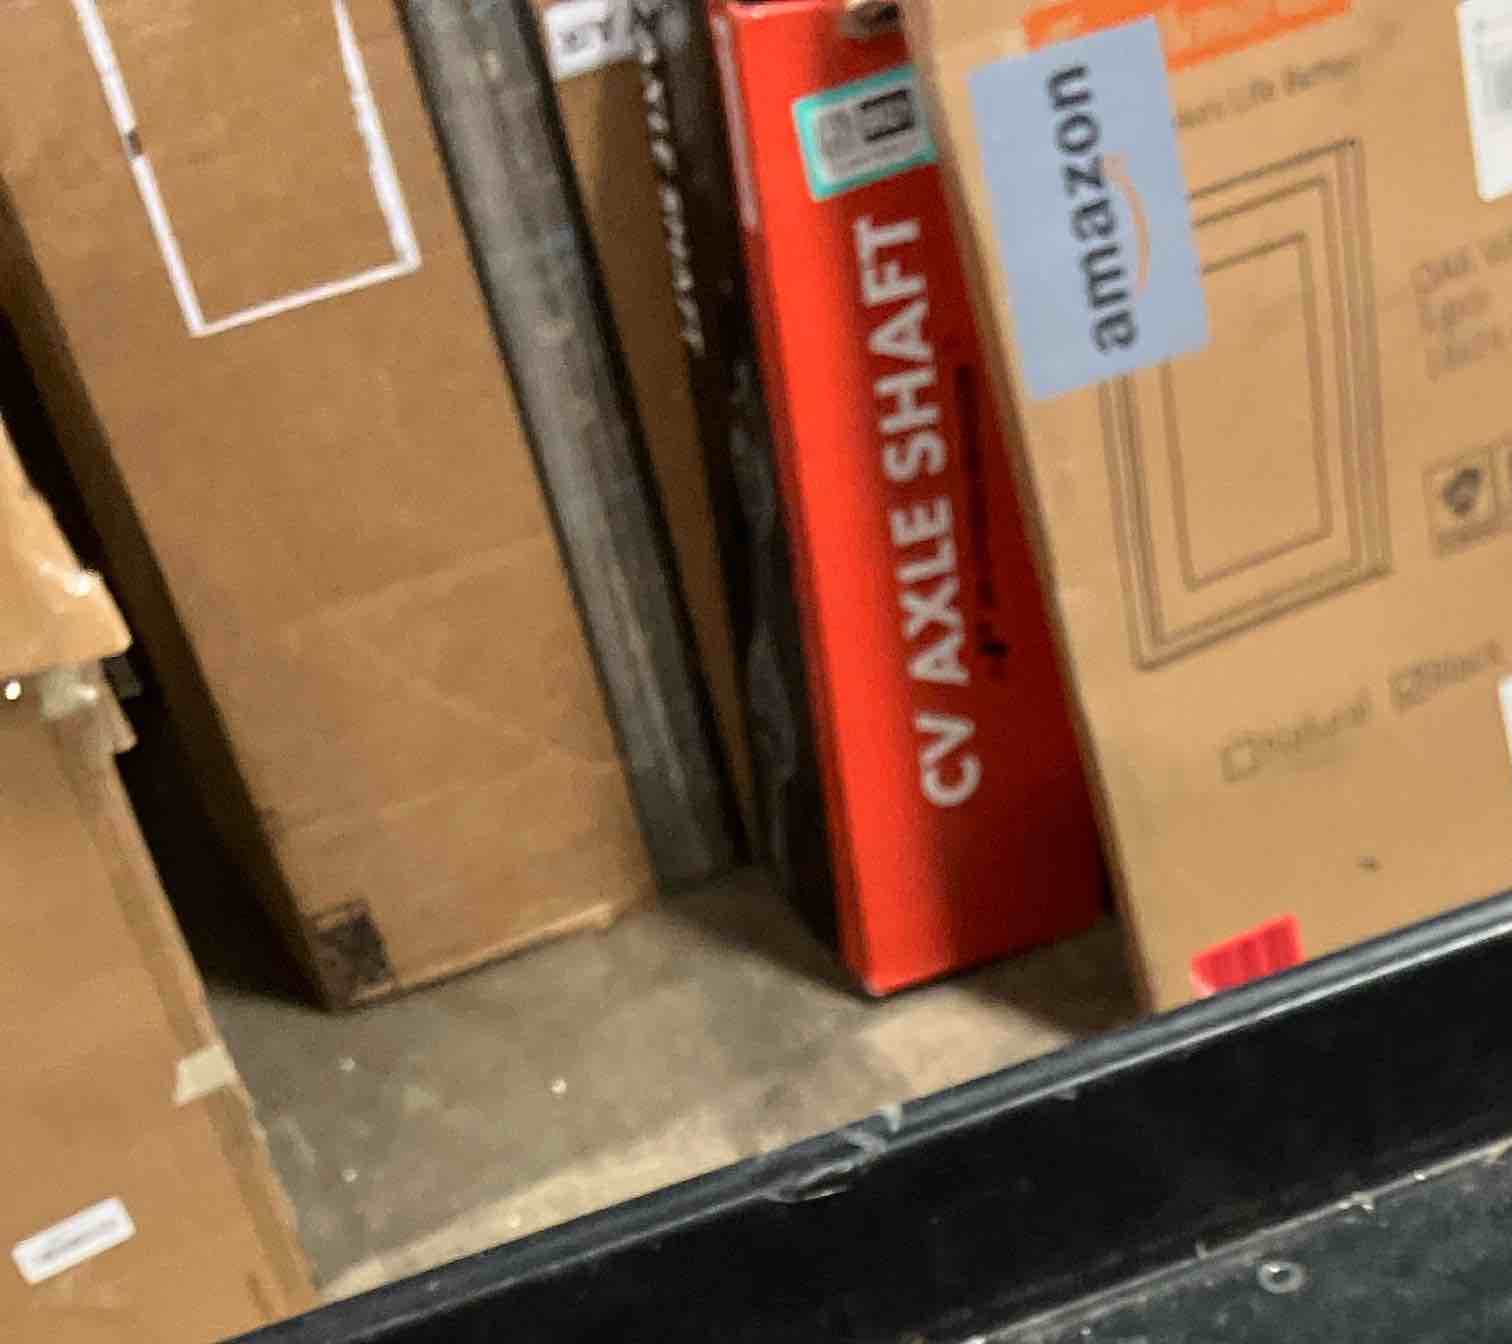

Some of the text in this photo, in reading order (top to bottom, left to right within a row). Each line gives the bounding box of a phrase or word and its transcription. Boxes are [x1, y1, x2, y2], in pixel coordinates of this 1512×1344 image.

[1047, 64, 1138, 354] amazon
[854, 215, 946, 485] SHAFT
[891, 497, 971, 687] AXLE
[914, 709, 982, 809] CV
